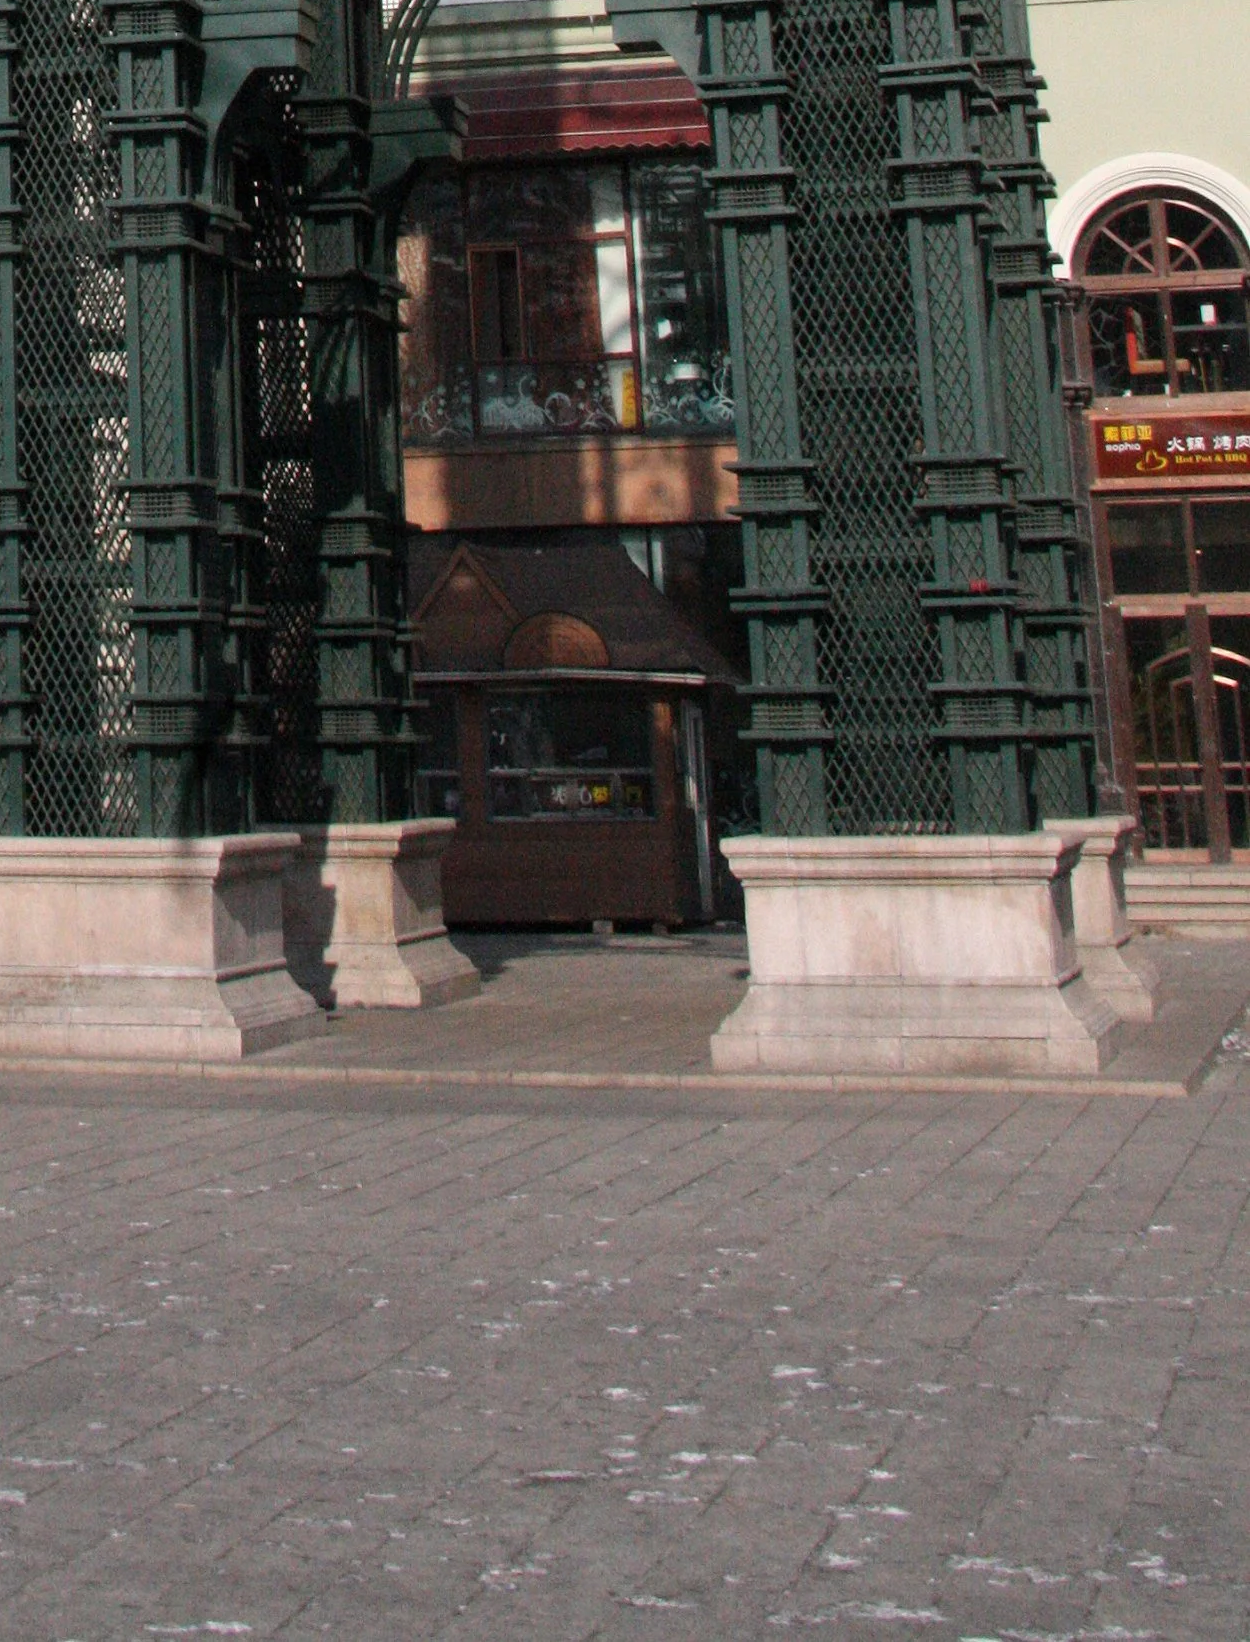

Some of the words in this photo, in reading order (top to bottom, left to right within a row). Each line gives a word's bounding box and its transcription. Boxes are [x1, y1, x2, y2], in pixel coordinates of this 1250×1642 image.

[1166, 436, 1206, 452] 火锅
[1175, 455, 1193, 464] Hot
[1195, 454, 1212, 464] Pot
[1225, 453, 1247, 463] BBQ
